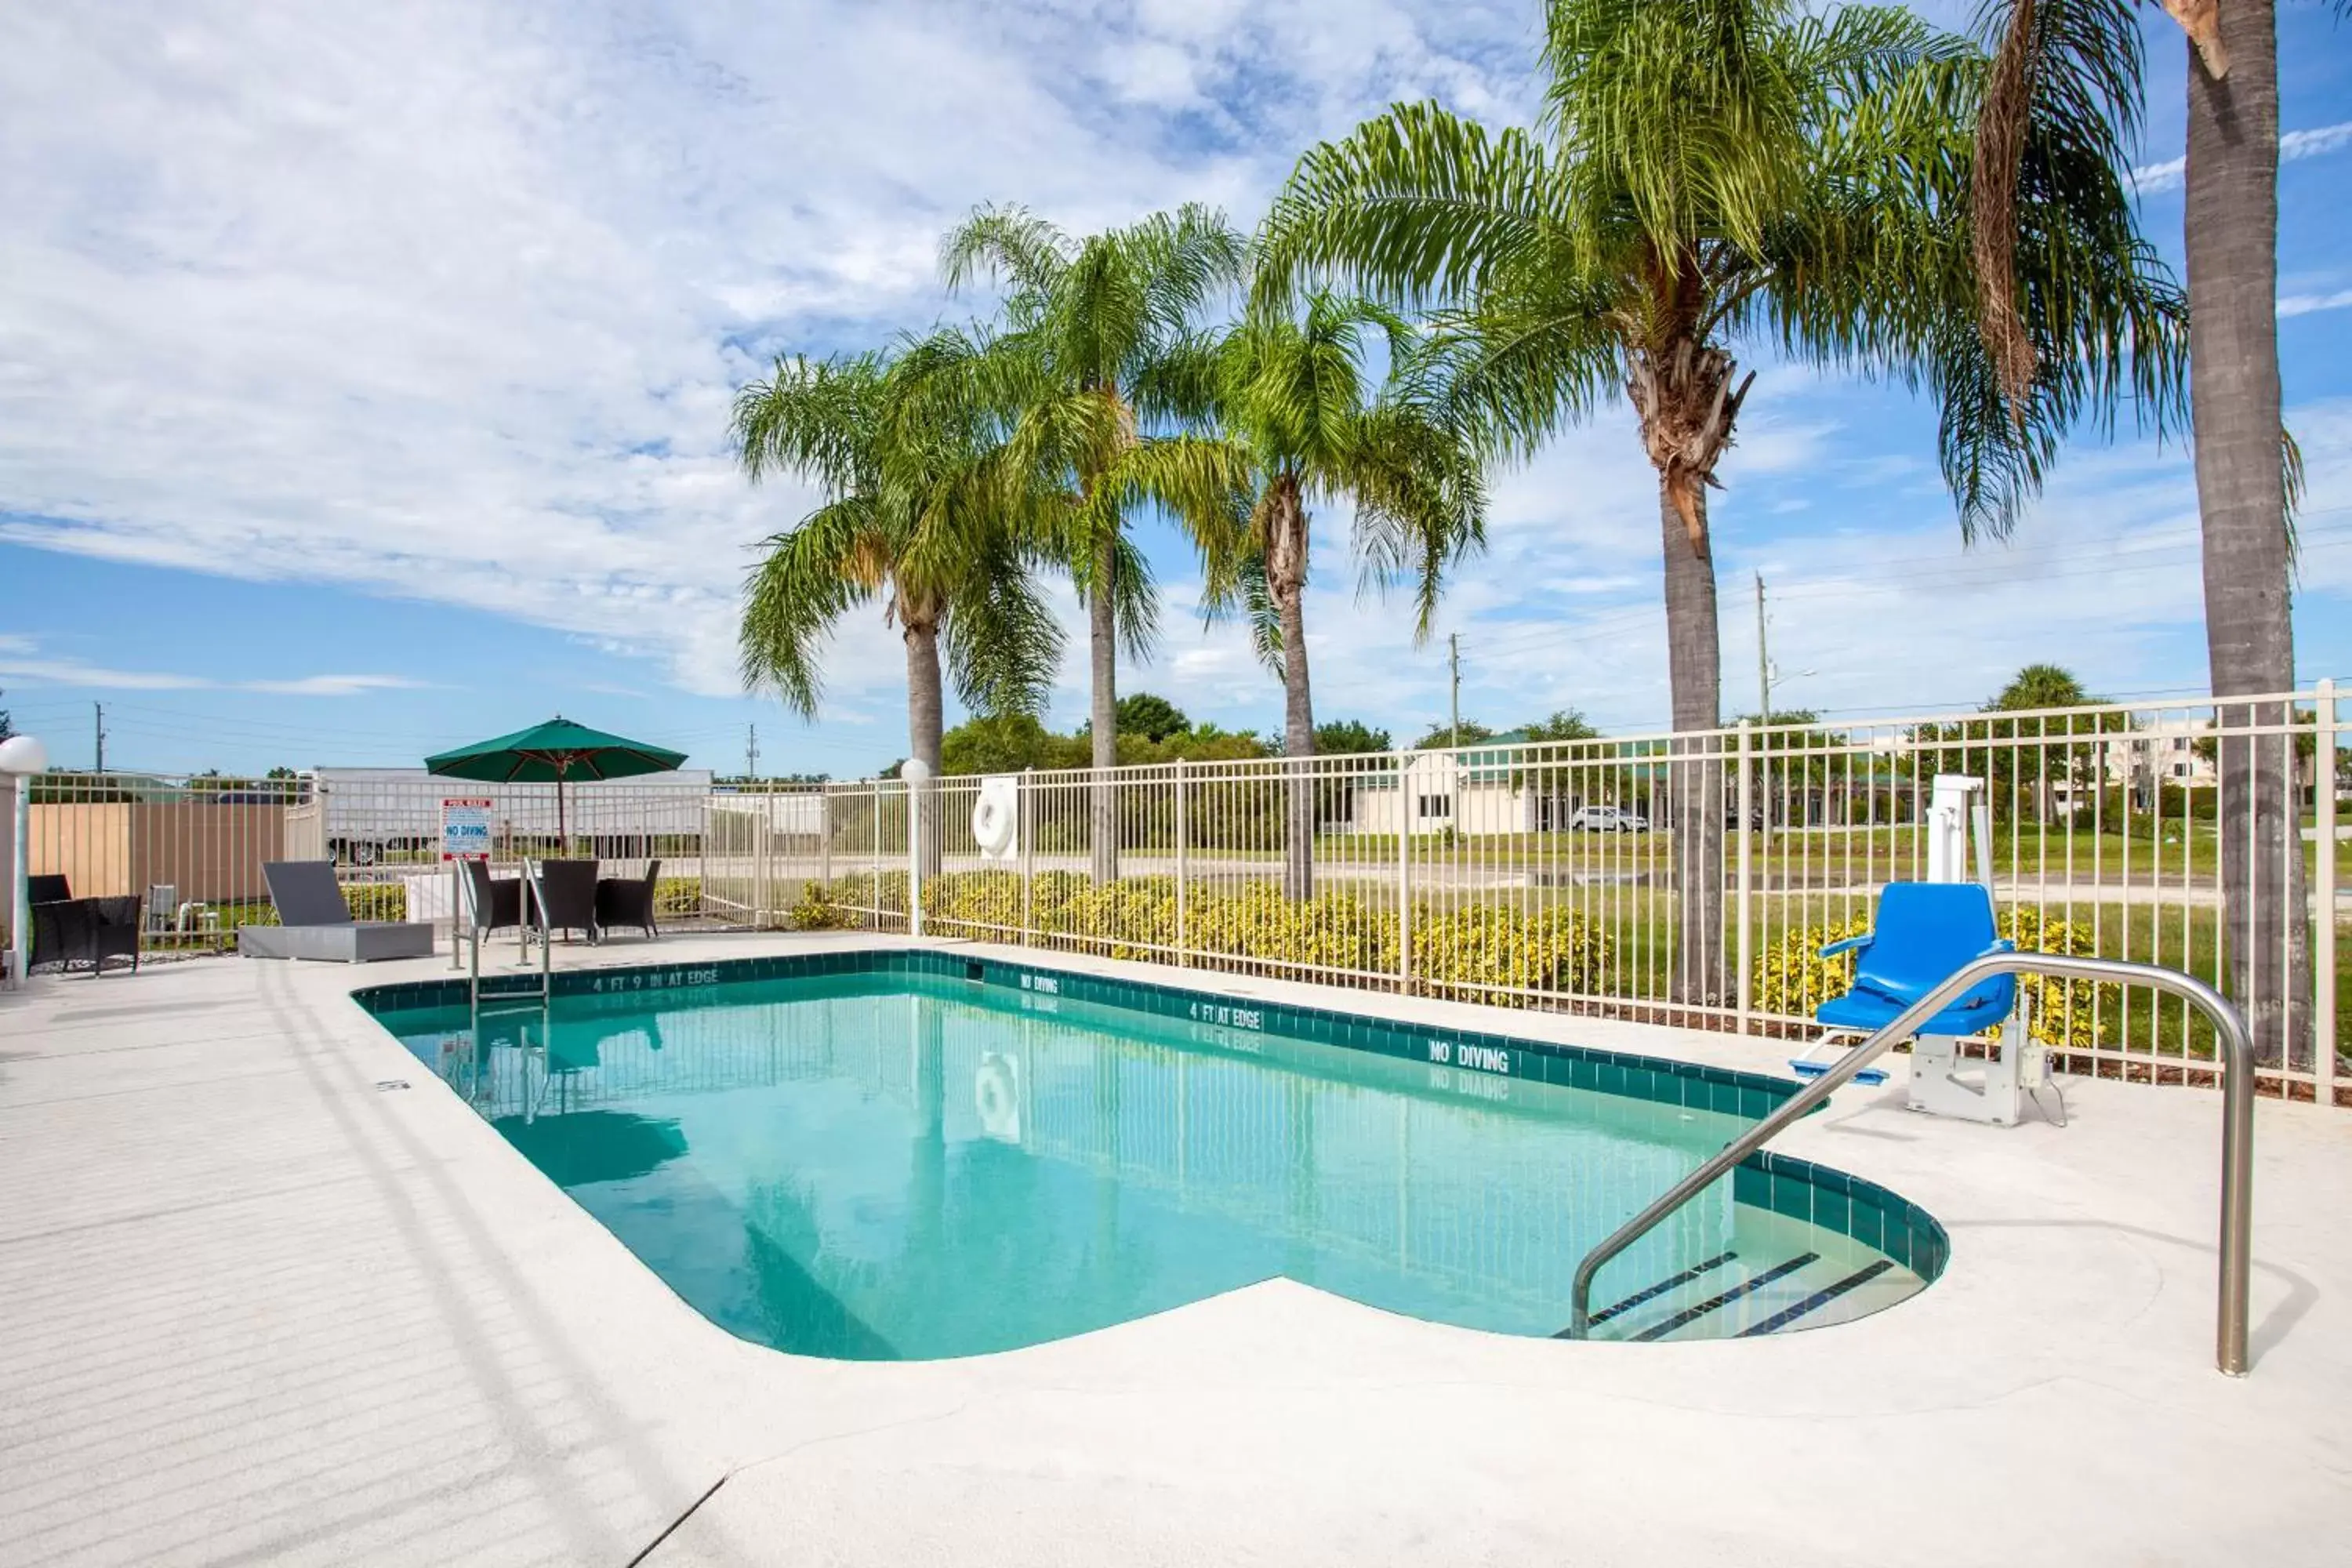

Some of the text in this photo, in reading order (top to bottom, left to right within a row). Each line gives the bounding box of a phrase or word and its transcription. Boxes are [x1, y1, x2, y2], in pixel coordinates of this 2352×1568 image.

[446, 826, 488, 837] NO DIVING
[593, 969, 718, 992] 4 FT 9 IN AT EDGE
[1020, 974, 1058, 994] NO DIVING
[1189, 1002, 1260, 1029] 4 FT AT EDGE
[1430, 1040, 1509, 1073] NO DIVING
